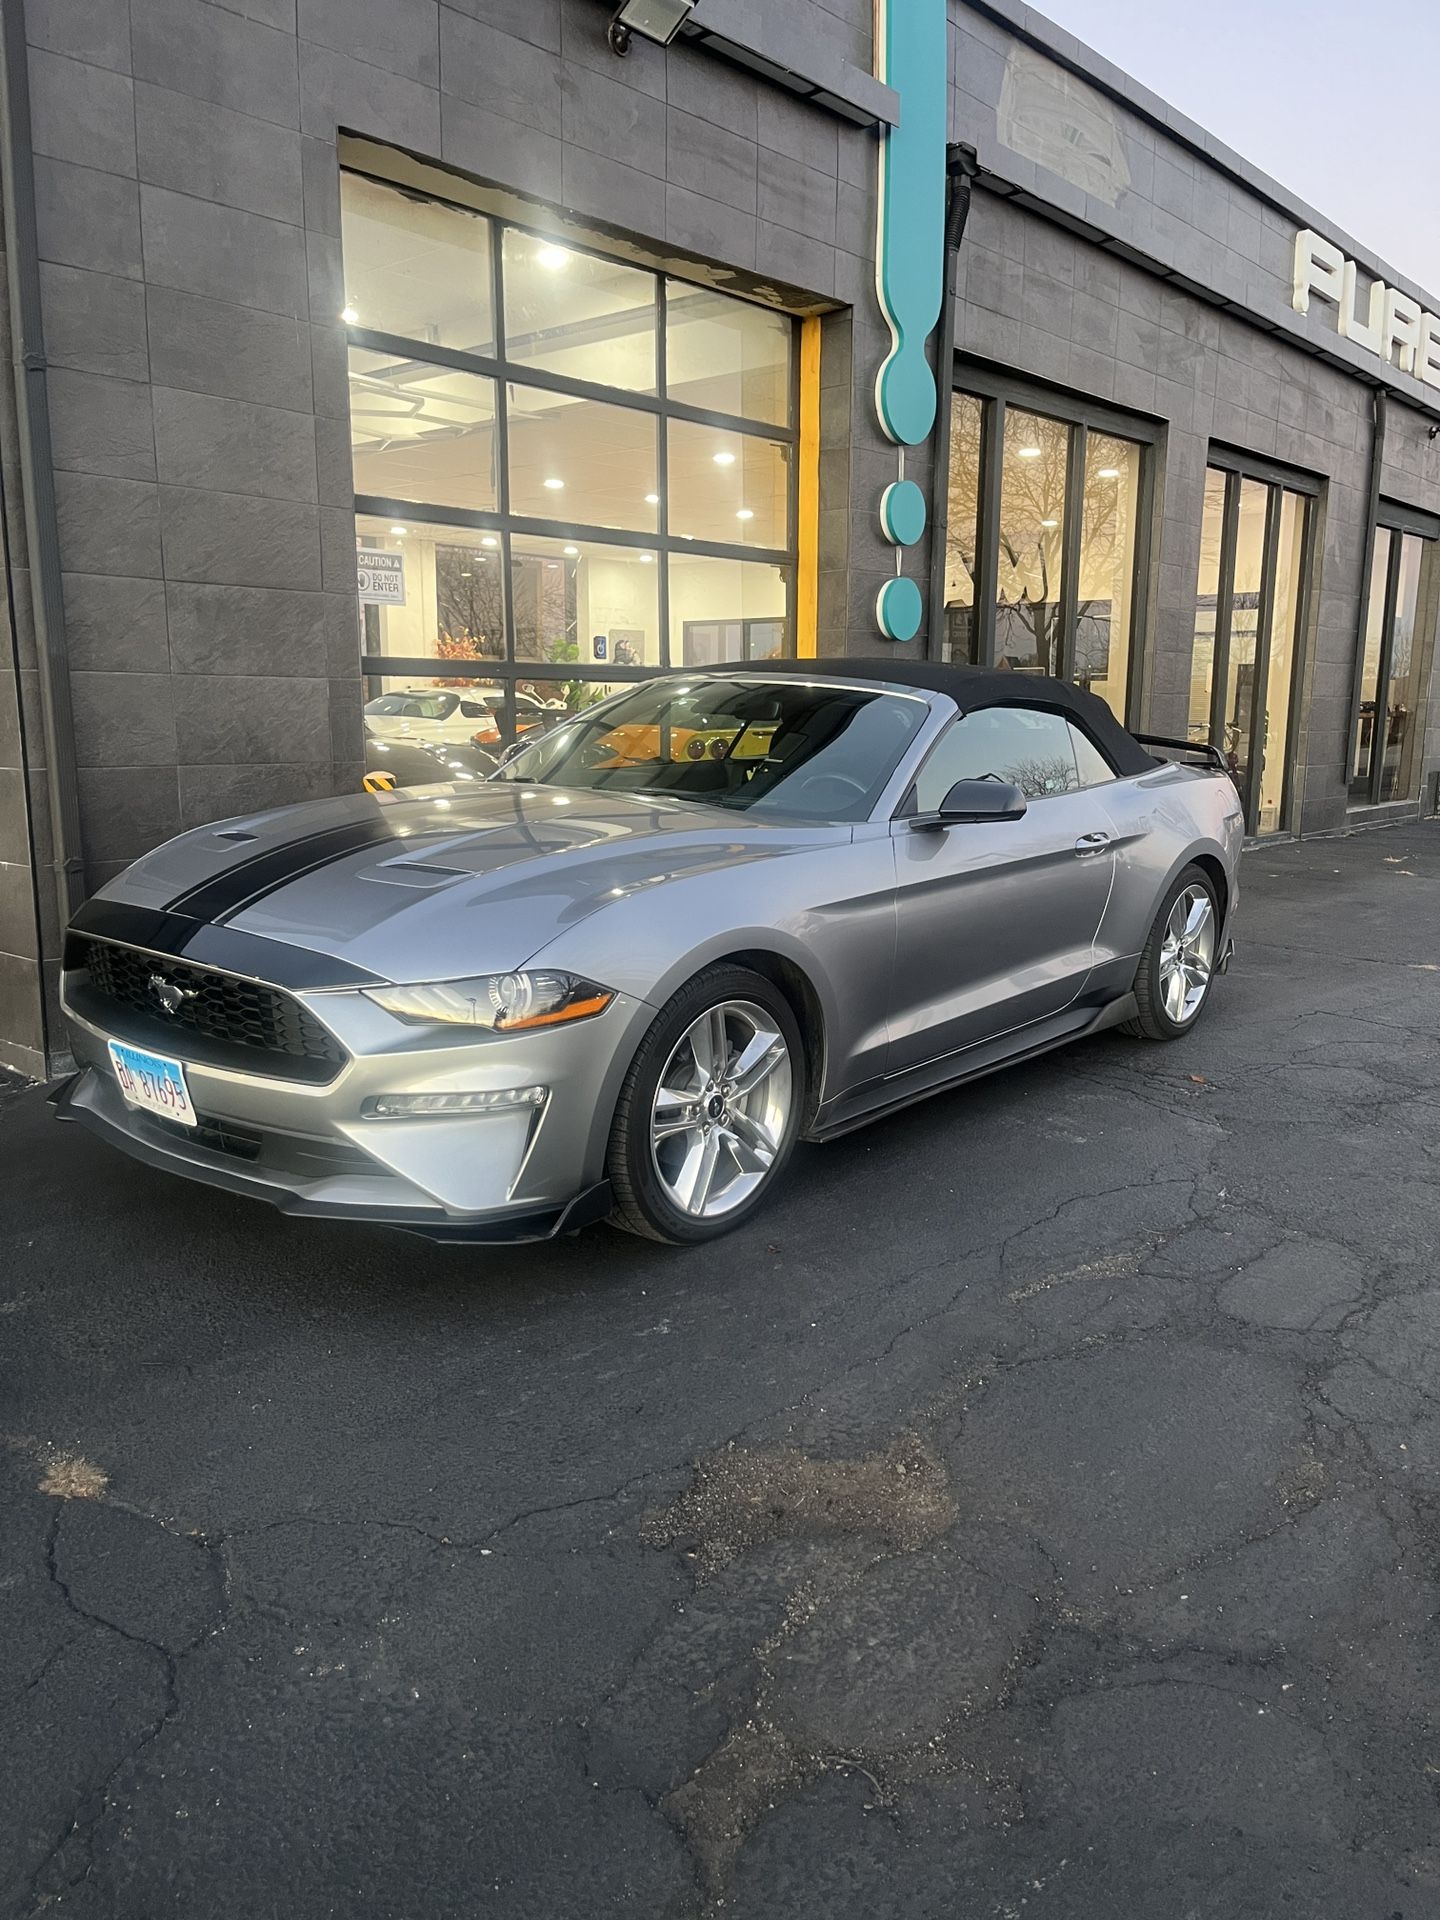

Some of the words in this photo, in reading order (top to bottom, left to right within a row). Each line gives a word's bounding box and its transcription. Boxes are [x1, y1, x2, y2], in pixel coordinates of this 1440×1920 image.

[359, 555, 391, 567] CAUTION
[373, 573, 382, 581] DO
[384, 574, 398, 582] NOT
[373, 582, 399, 592] ENTER
[139, 1070, 186, 1110] 87695
